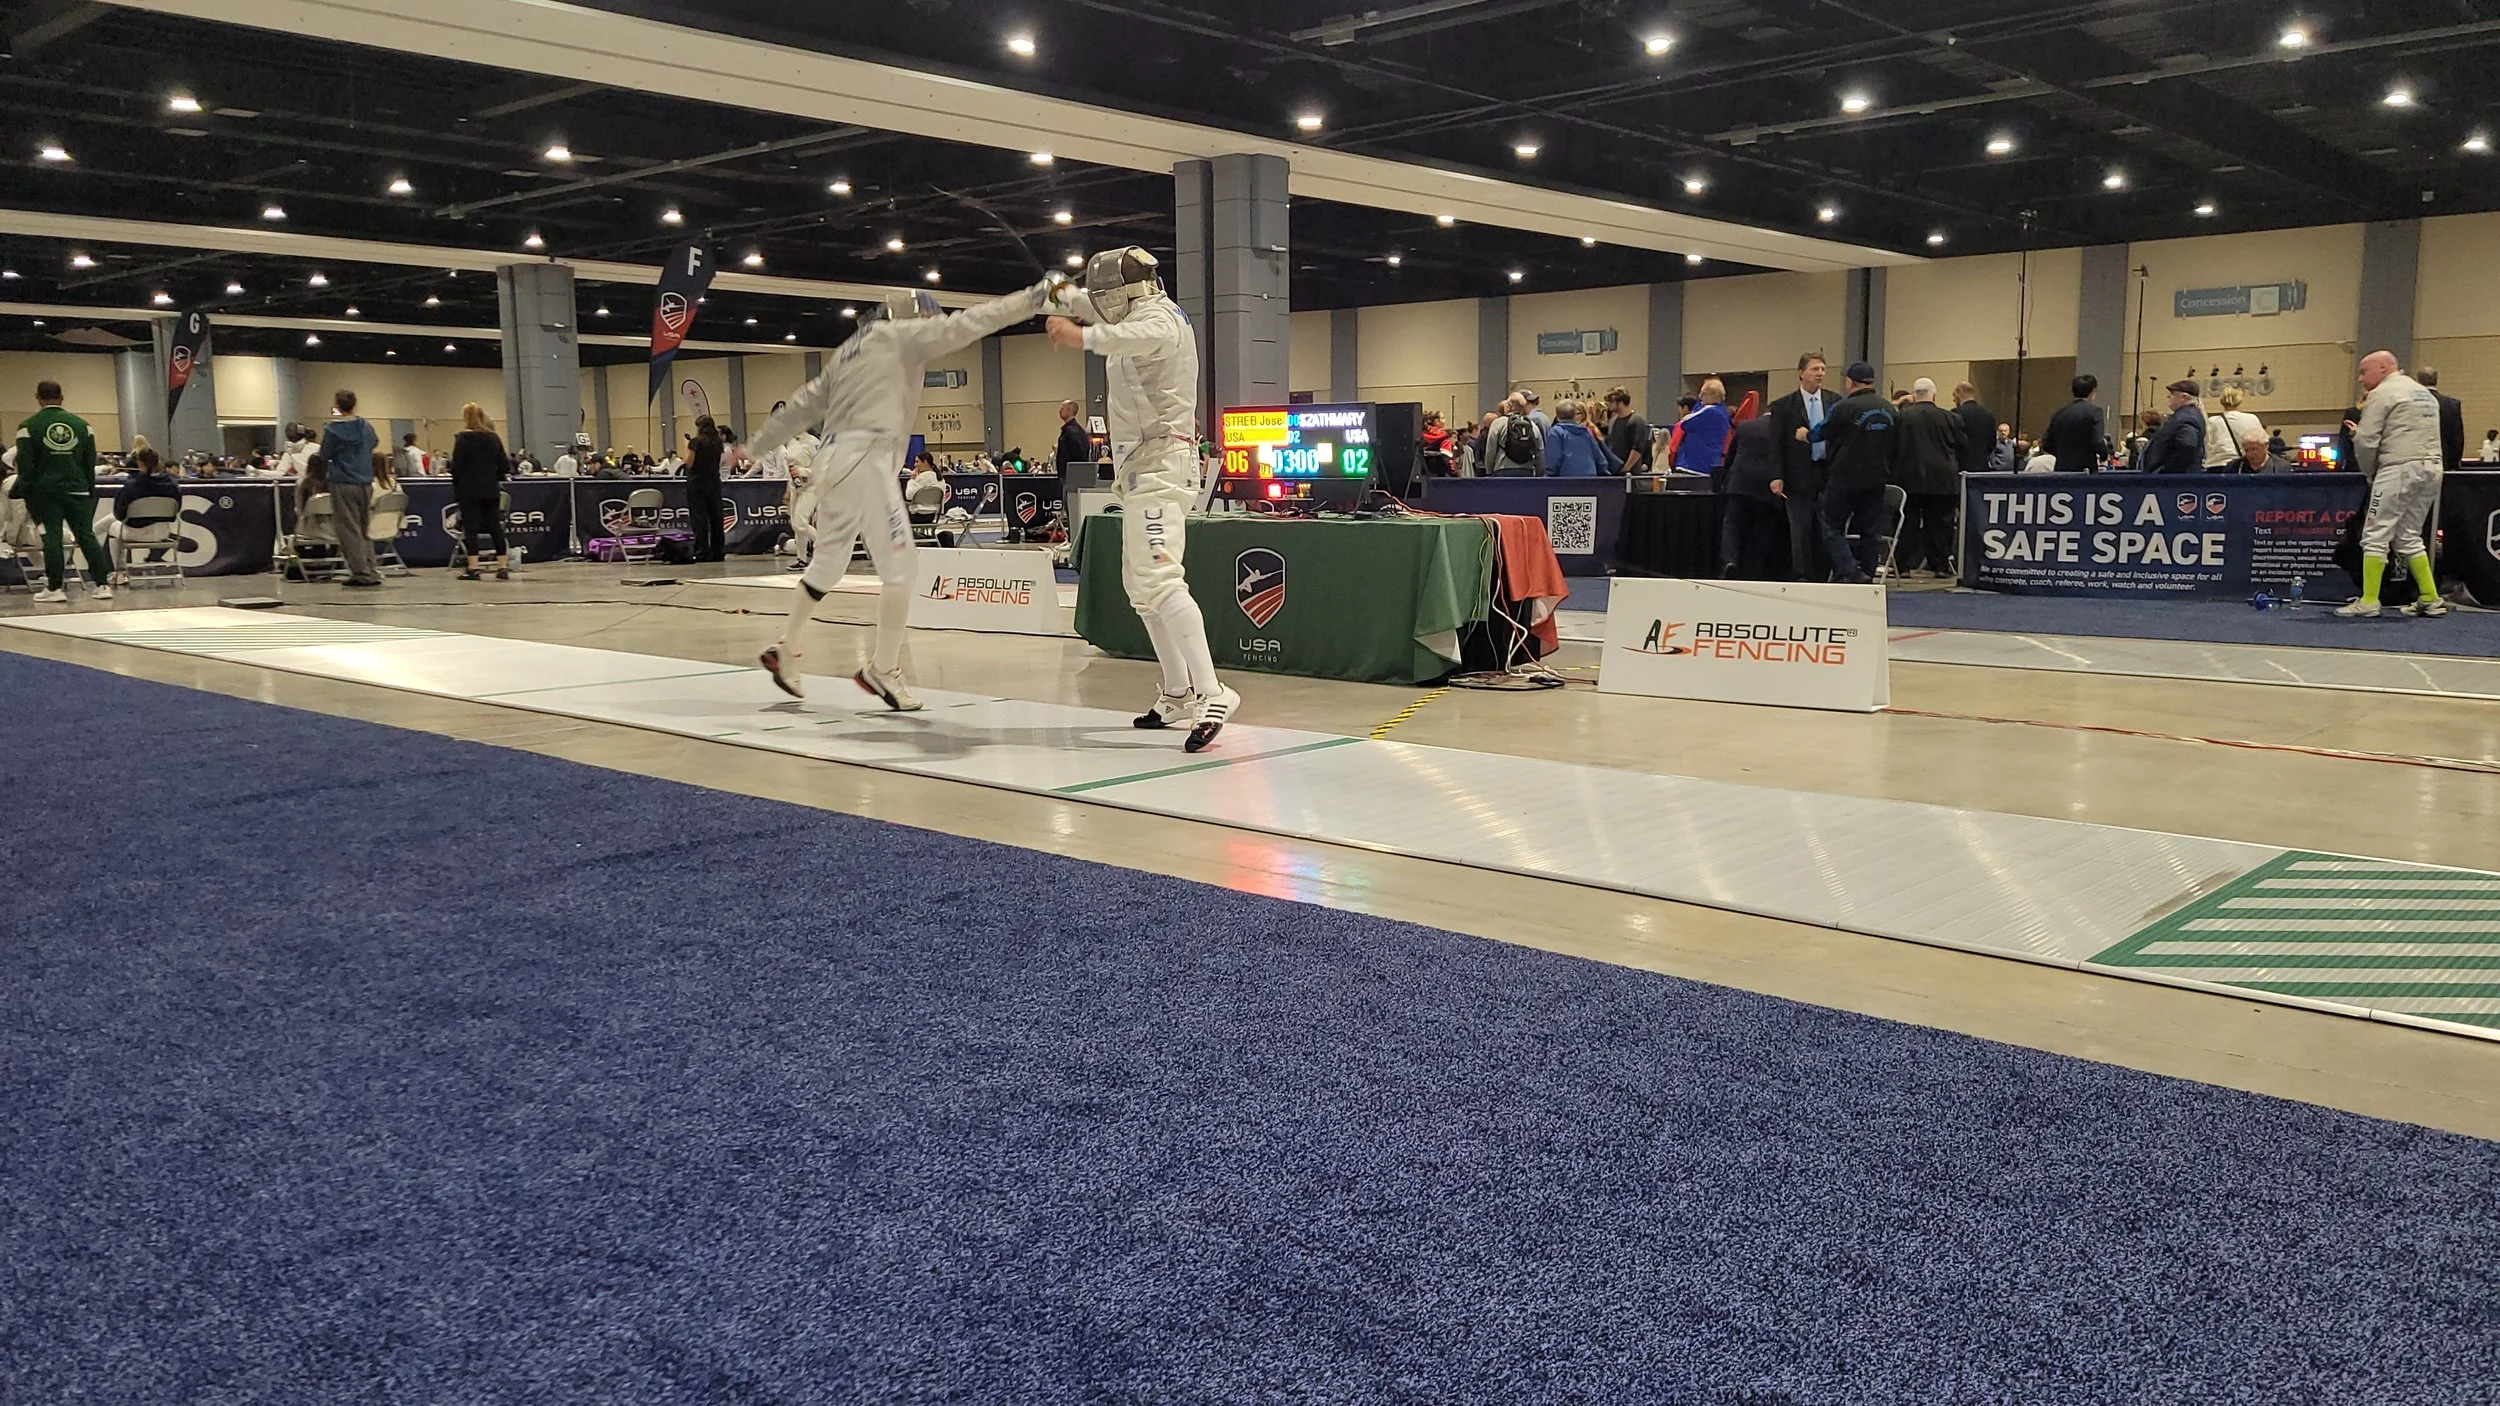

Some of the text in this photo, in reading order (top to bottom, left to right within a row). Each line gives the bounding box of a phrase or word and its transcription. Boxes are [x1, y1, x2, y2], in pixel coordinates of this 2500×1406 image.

[687, 246, 703, 277] F
[2180, 294, 2246, 309] Concession
[189, 312, 201, 334] G
[1225, 414, 1283, 427] STREB Jose
[1299, 411, 1366, 428] SZATHMARY
[1225, 431, 1245, 443] USA
[1347, 429, 1370, 443] USA
[1225, 449, 1249, 474] 06
[1342, 448, 1369, 474] 02
[2303, 449, 2317, 459] 10
[955, 488, 978, 496] USA
[1983, 493, 2165, 526] THIS IS A
[2255, 510, 2316, 523] REPORT
[2320, 510, 2331, 523] A
[1144, 508, 1165, 551] USA
[2254, 526, 2272, 535] Text
[1983, 529, 2226, 566] SAFE SPACE
[1980, 565, 1990, 573] We
[1991, 566, 2004, 574] are
[2005, 566, 2047, 576] committed
[2047, 568, 2056, 576] to
[2057, 568, 2090, 579] creating
[2098, 570, 2115, 578] safe
[2116, 570, 2131, 578] and
[2133, 571, 2170, 580] inclusive
[2171, 573, 2195, 581] space
[2196, 572, 2210, 581] for
[2210, 572, 2223, 581] all
[1995, 576, 2028, 586] compete,
[2030, 578, 2053, 587] coach,
[2055, 578, 2085, 588] referee,
[2087, 580, 2110, 588] work,
[2111, 580, 2136, 589] watch
[2137, 581, 2153, 589] and
[2155, 582, 2197, 591] volunteer.
[955, 588, 1030, 605] FENCING
[1239, 637, 1281, 653] USA
[1692, 638, 1847, 666] FENCING
[1244, 654, 1277, 663] FENCING
